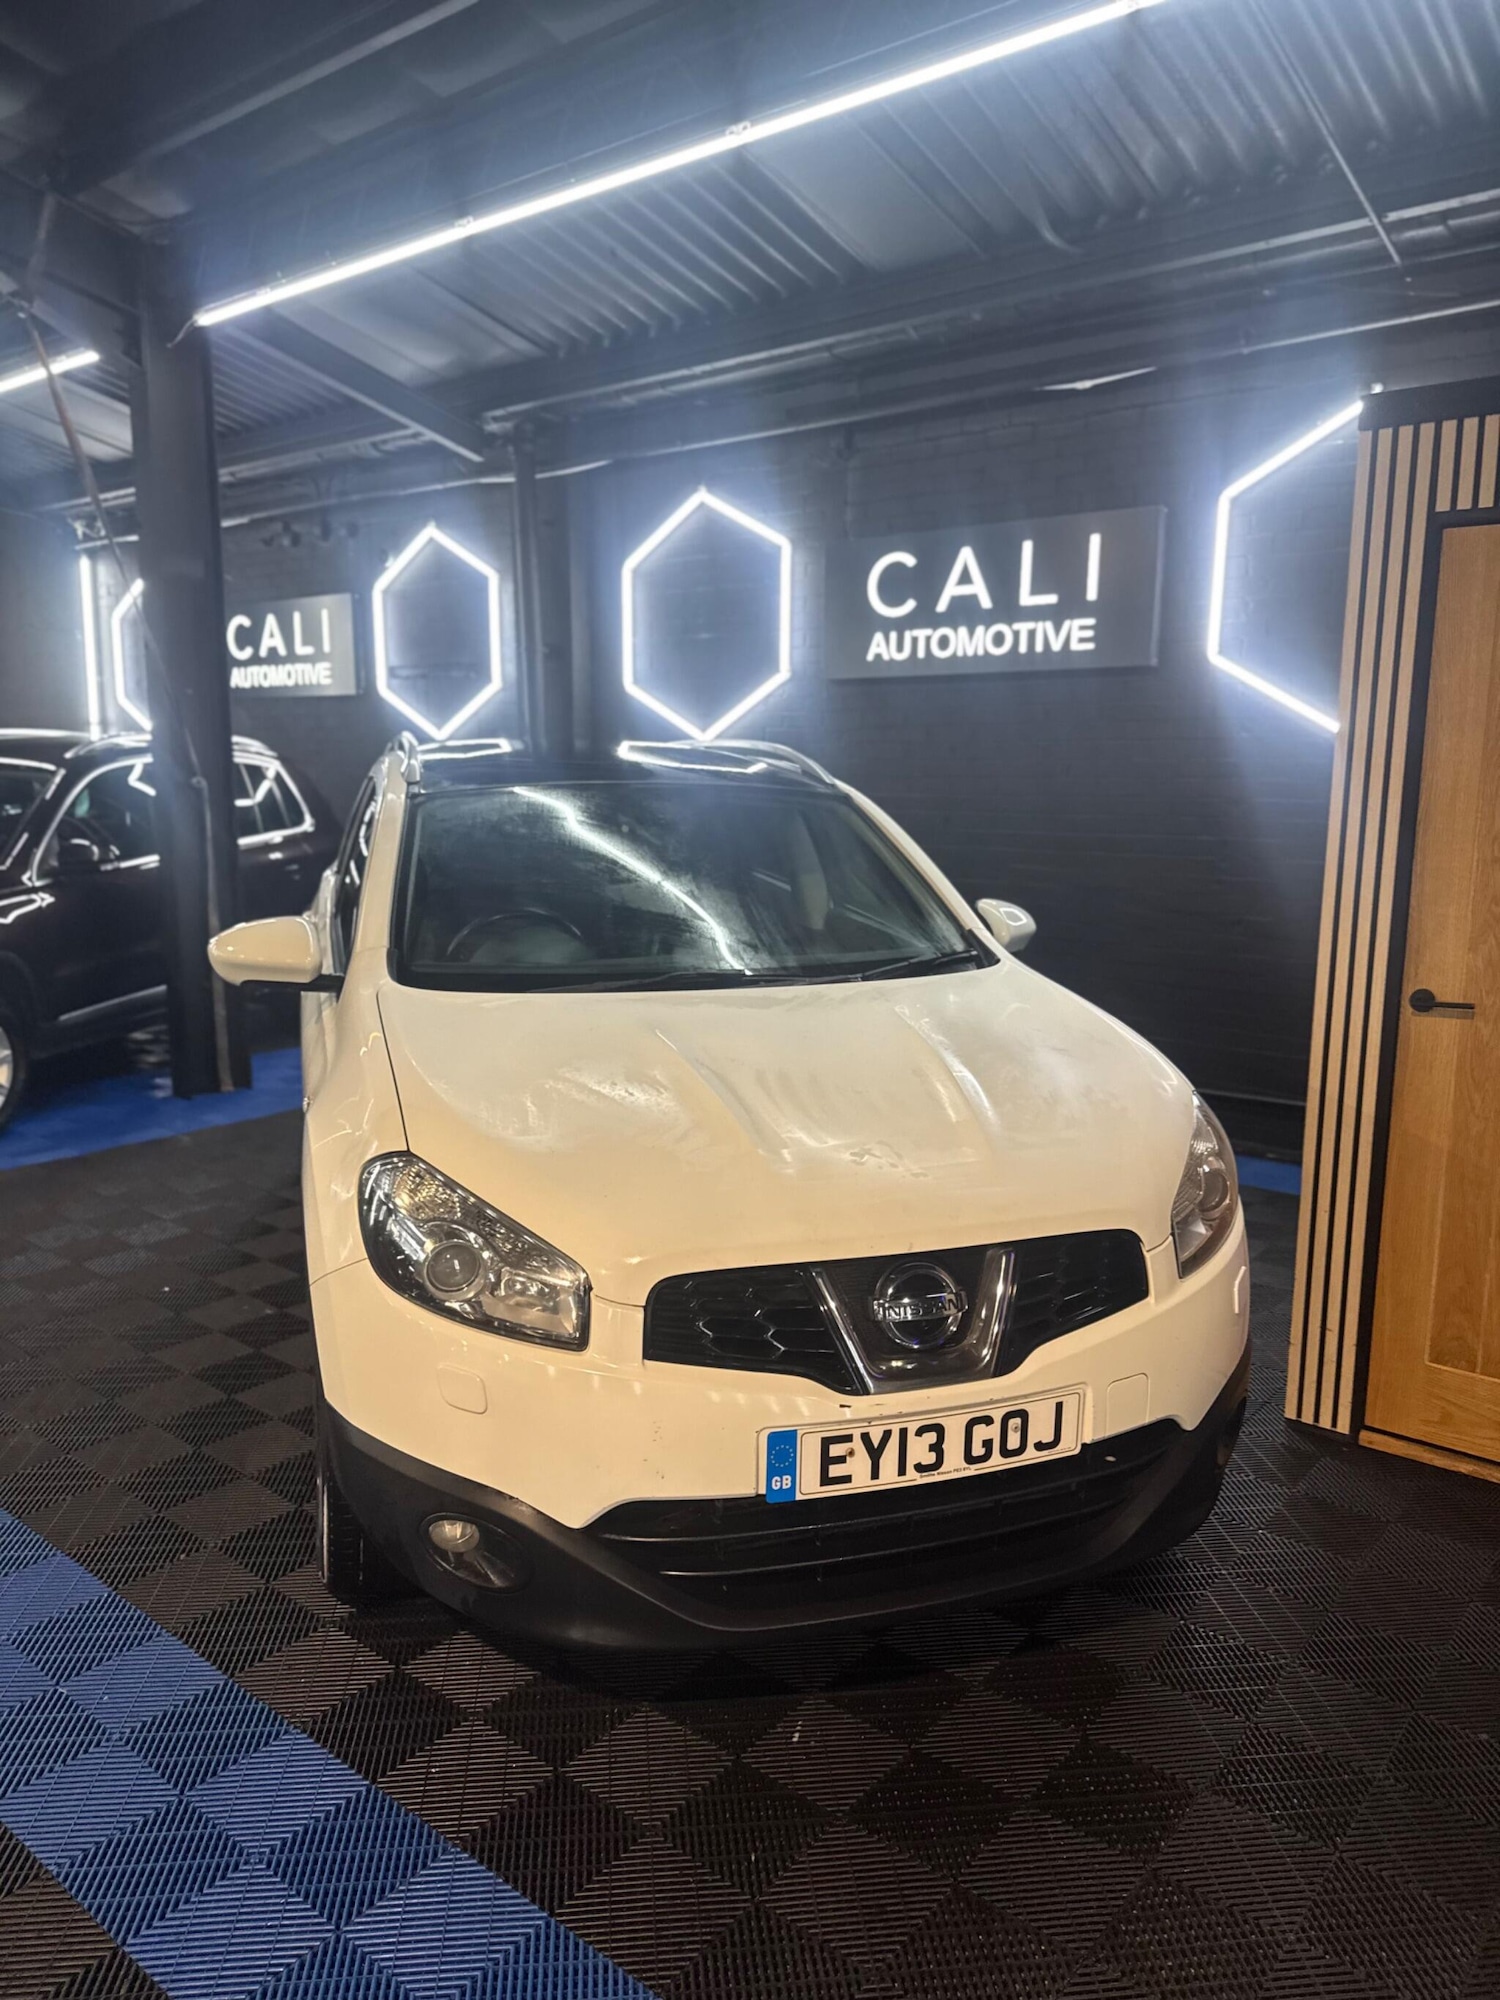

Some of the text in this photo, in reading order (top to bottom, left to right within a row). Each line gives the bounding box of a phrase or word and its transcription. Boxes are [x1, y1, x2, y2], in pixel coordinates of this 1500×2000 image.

[866, 533, 1101, 618] CALI
[226, 608, 331, 661] CALI
[866, 617, 1097, 662] AUTOMOTIVE
[230, 662, 332, 689] AUTOMOTIVE
[819, 1401, 1064, 1487] EY13 GOJ
[771, 1475, 792, 1490] GB
